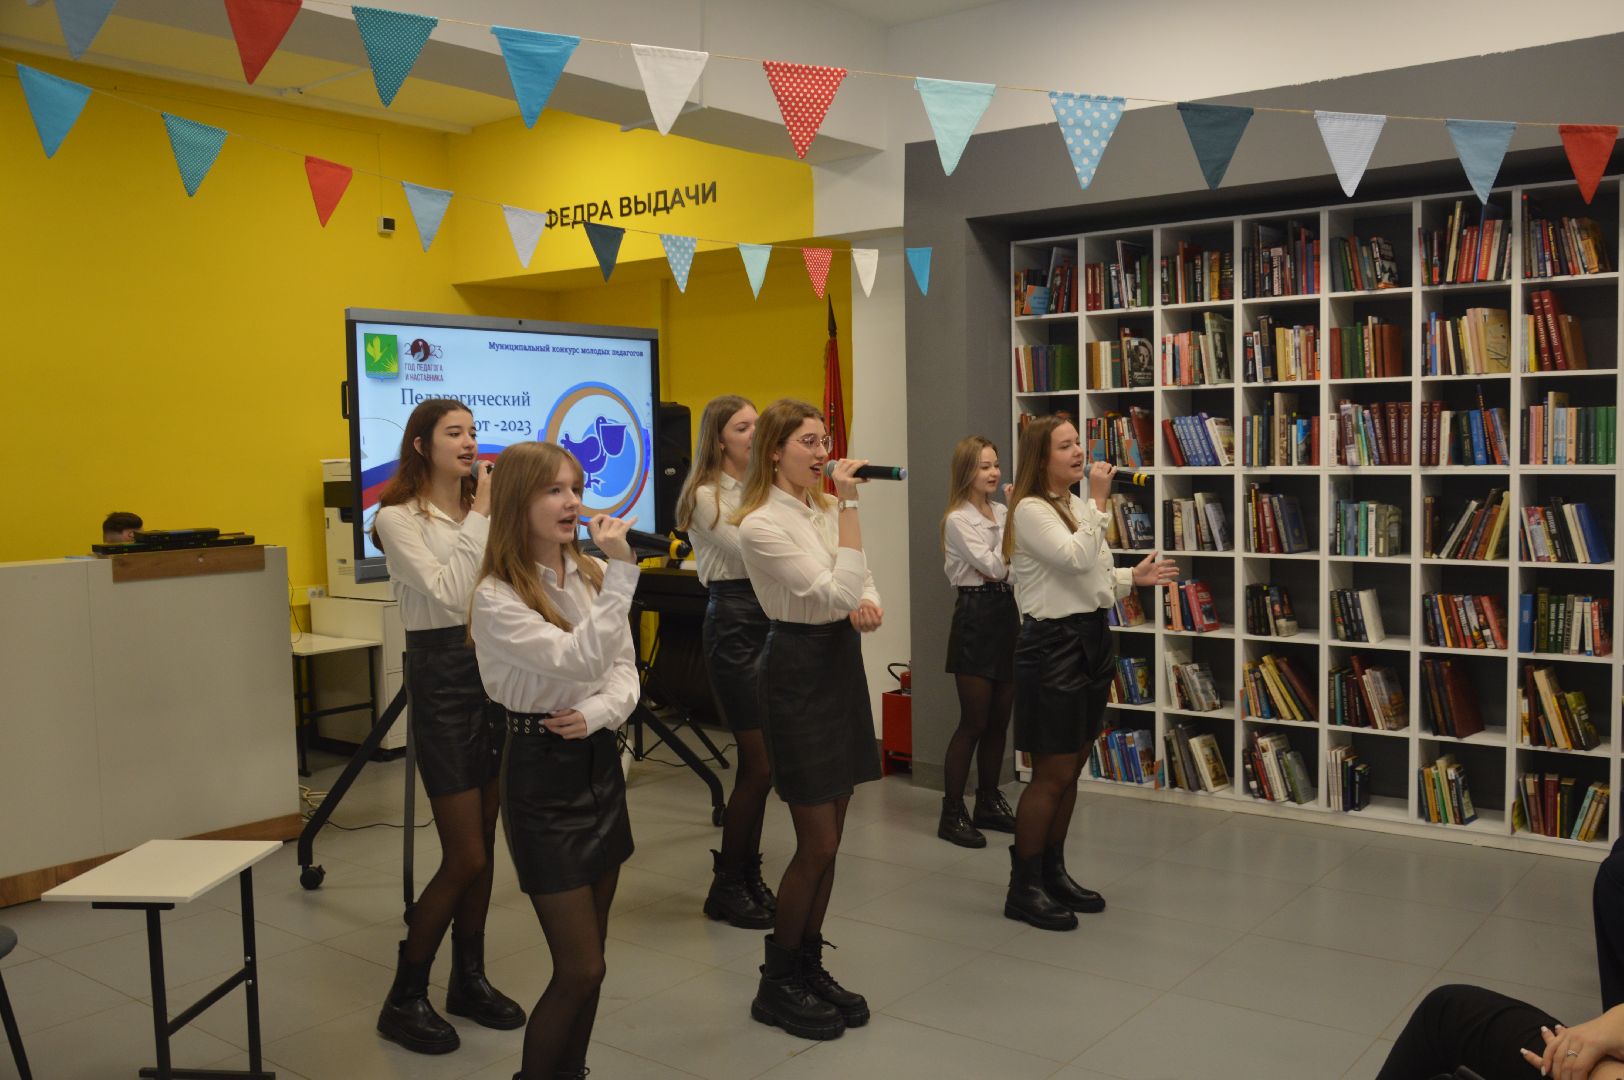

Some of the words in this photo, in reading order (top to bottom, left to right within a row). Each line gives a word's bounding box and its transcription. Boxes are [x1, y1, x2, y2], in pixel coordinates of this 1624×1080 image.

[619, 181, 717, 217] ВЫДАЧИ
[488, 341, 550, 353] Муниципальный
[552, 346, 580, 356] конкурс
[581, 347, 610, 356] молодых
[612, 349, 644, 358] педагогов
[405, 363, 416, 371] ГОД
[417, 363, 444, 372] ПЕДАГОГА
[410, 373, 444, 382] НАСТАВНИКА
[494, 420, 532, 436] -2023
